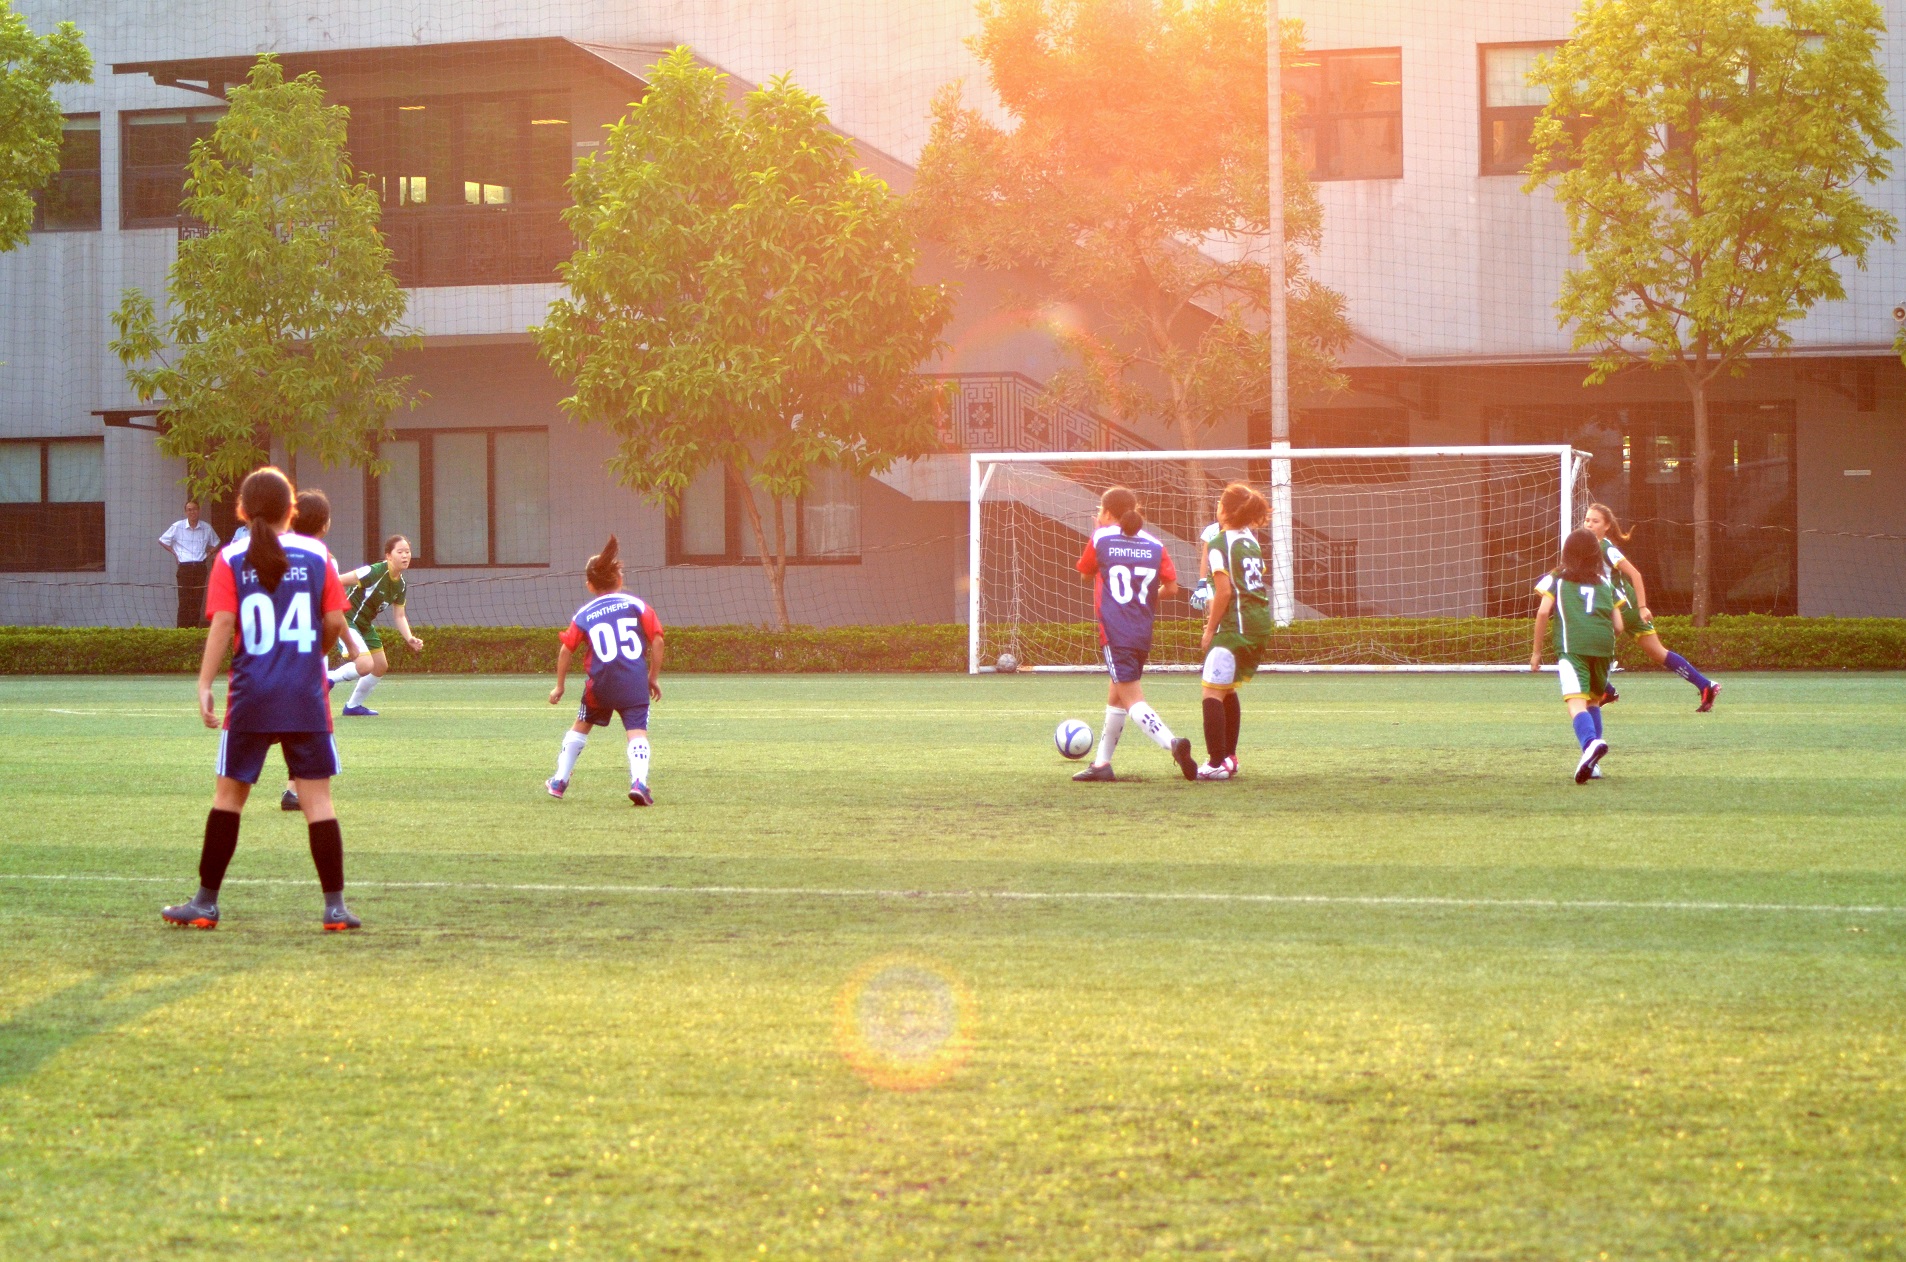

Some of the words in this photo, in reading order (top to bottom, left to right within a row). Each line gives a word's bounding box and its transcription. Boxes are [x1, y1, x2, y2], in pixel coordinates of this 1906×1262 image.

[1108, 547, 1152, 559] PANTHERS
[241, 566, 308, 585] PAERS
[1108, 564, 1157, 605] 07
[586, 601, 629, 622] PANTHERS
[1580, 586, 1595, 613] 7
[240, 592, 317, 656] 04
[589, 617, 643, 663] 05
